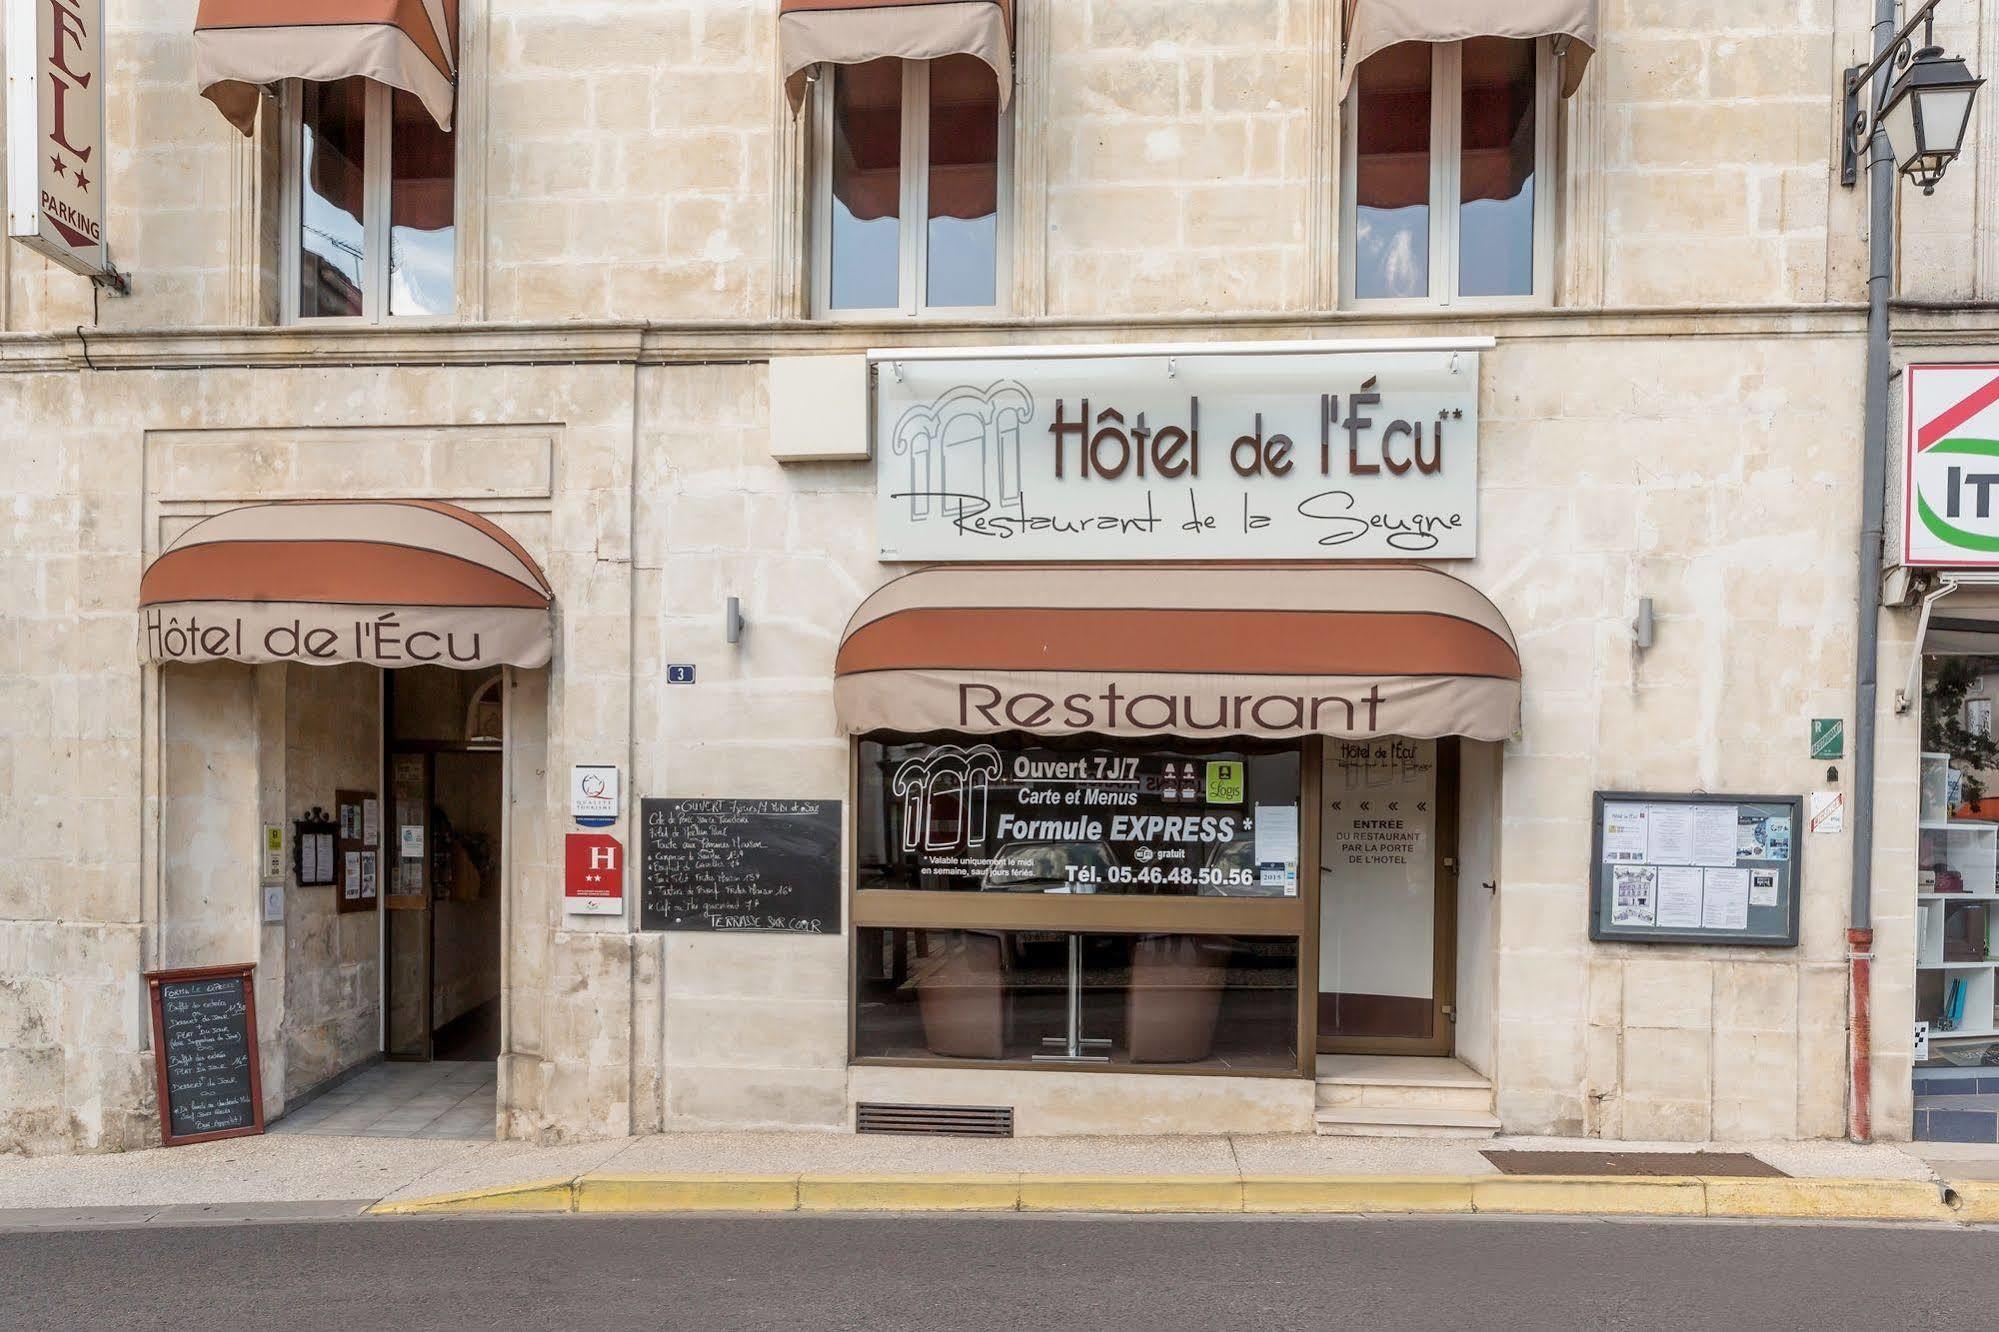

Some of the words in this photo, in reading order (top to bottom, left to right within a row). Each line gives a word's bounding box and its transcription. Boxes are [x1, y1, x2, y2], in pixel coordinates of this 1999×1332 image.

[48, 0, 92, 163] EL
[41, 190, 100, 240] PARKING
[1048, 396, 1198, 480] Hôtel
[1230, 413, 1293, 477] de
[891, 491, 1162, 540] Restaurant
[1182, 488, 1217, 533] de
[1244, 492, 1272, 535] la
[1298, 491, 1463, 550] Seugne
[147, 609, 242, 658] Hôtel
[264, 620, 339, 658] de
[355, 612, 481, 661] l'Écu
[677, 668, 684, 680] 3
[959, 683, 1386, 733] Restaurant
[1375, 746, 1387, 759] de
[1014, 756, 1087, 779] Ouvert
[1094, 757, 1140, 779] 7J/7
[1018, 788, 1062, 805] Carte
[1065, 789, 1084, 805] et
[1089, 789, 1138, 806] Menus
[1210, 780, 1240, 800] Logis
[996, 814, 1103, 841] Formule
[1110, 816, 1235, 843] EXPRESS
[1336, 832, 1349, 841] DU
[1353, 832, 1420, 841] RESTAURANT
[589, 847, 616, 870] H
[1158, 848, 1185, 861] gratuit
[1342, 843, 1361, 853] PAR
[1365, 843, 1377, 853] LA
[1380, 843, 1413, 853] PORTE
[929, 856, 958, 865] Valable
[960, 857, 1006, 867] uniquement
[1349, 855, 1361, 864] DE
[1065, 864, 1102, 883] Tél.
[1108, 866, 1253, 886] 05.46.48.50.56
